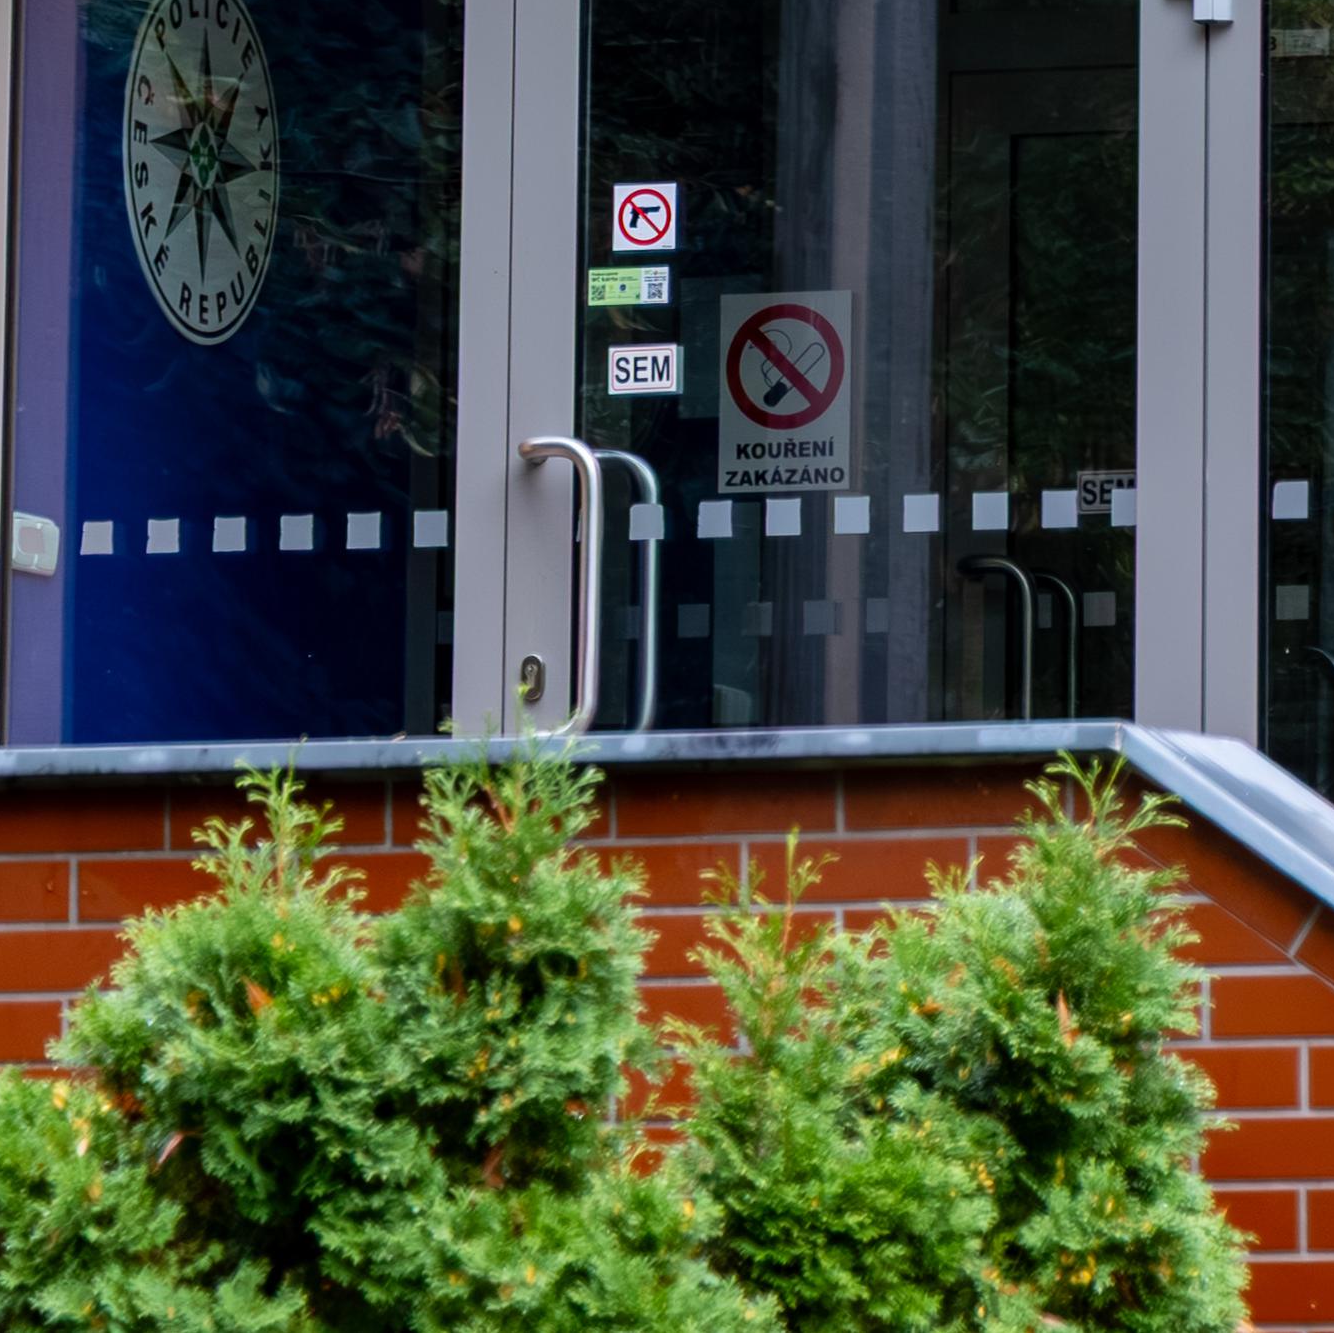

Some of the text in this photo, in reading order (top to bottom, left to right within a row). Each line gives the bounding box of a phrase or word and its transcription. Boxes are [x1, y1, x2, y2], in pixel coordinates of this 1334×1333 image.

[177, 103, 274, 326] REPUBLIKY
[615, 355, 671, 384] SEM
[736, 437, 834, 459] KOUŘENÍ
[725, 466, 845, 487] ZAKÁZÁNO
